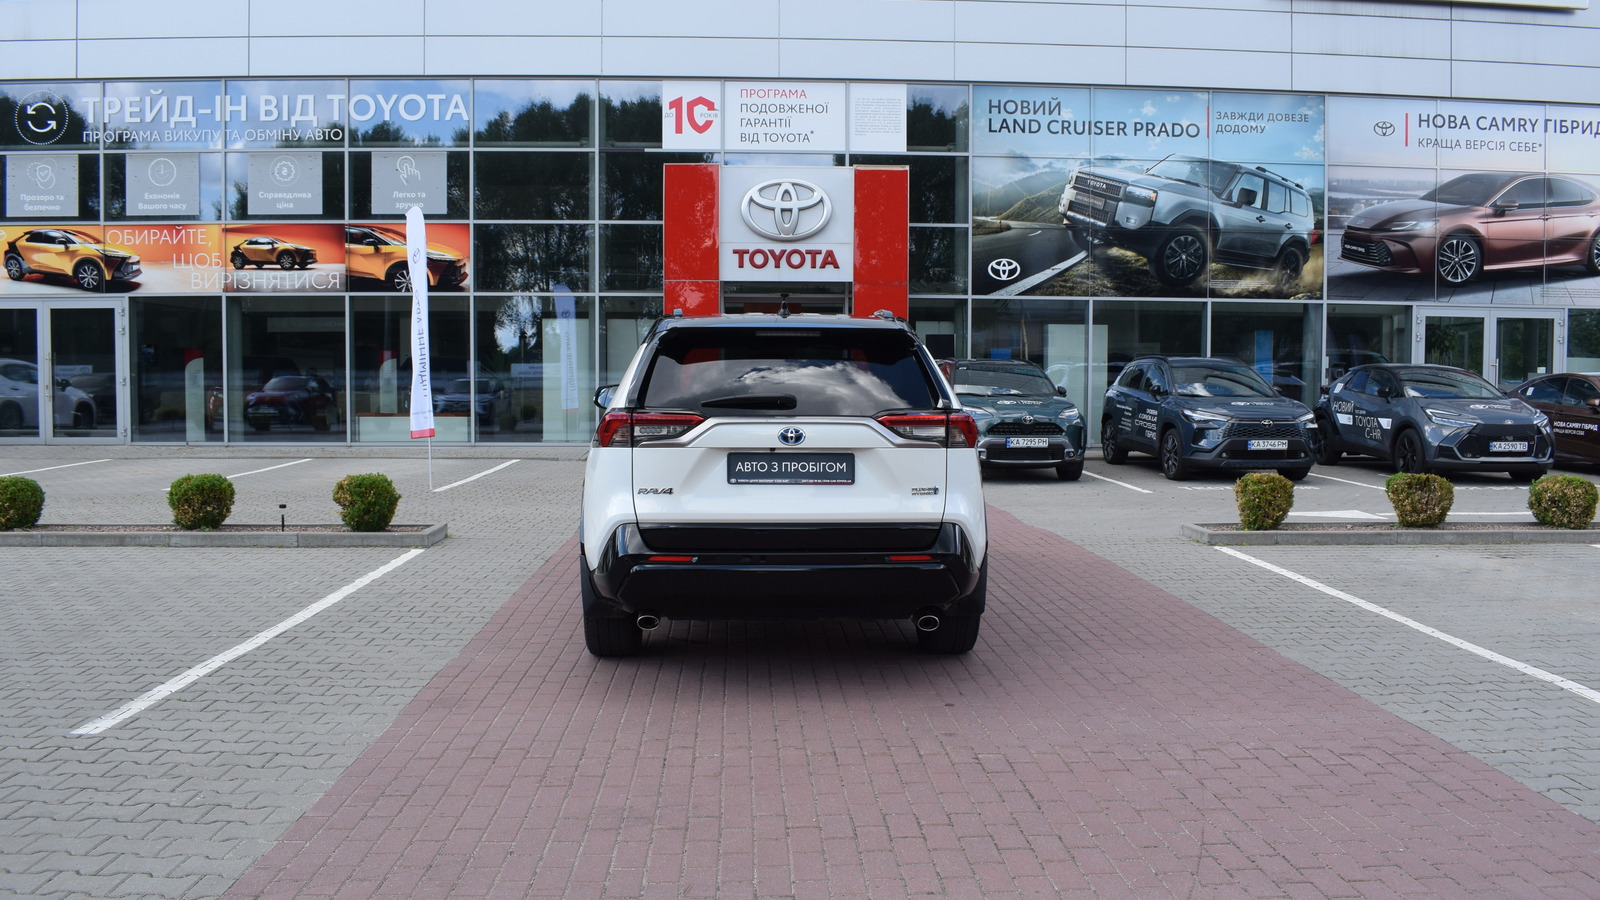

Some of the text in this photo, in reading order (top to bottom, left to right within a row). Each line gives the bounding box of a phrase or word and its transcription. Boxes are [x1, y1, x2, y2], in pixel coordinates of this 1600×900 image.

[740, 89, 807, 99] ПРОГРАМА
[82, 89, 469, 128] ТРЕЙД-ІН ВІД TOYOTA
[740, 101, 829, 115] ПОДОВЖЕНОЇ
[988, 97, 1062, 116] НОВИЙ
[740, 116, 792, 128] ГАРАНТІЇ
[1216, 111, 1309, 124] ЗАВЖДИ ДОВЕЗЕ
[1418, 113, 1471, 130] НОВА
[1476, 115, 1539, 133] CAMRY
[988, 118, 1200, 138] LAND CRUISER PRADO
[1216, 123, 1266, 136] ДОДОМУ
[83, 128, 343, 143] ПРОГРАМА ВИКУПУ ТА ОБМІНУ АВТО
[740, 133, 760, 145] ВІД
[1418, 138, 1461, 151] КРАЩА
[1465, 140, 1505, 151] ВЕРСІЯ
[1087, 180, 1107, 189] TOYOTA
[20, 193, 54, 202] Прозоро
[258, 191, 312, 199] Справедлива
[24, 203, 60, 211] безпечно
[276, 201, 294, 209] ціна
[173, 252, 222, 271] ЩОБ
[732, 249, 840, 269] TOYOTA
[191, 272, 340, 289] ВИРІЗНЯТИСЯ
[1333, 401, 1354, 412] НОВИЙ
[1134, 419, 1157, 430] CROSS
[1355, 416, 1378, 428] TOYOTA
[1365, 428, 1382, 439] C-HR
[735, 462, 768, 472] АВТО
[782, 462, 847, 472] ПРОБІГОМ
[637, 487, 674, 495] RAV4
